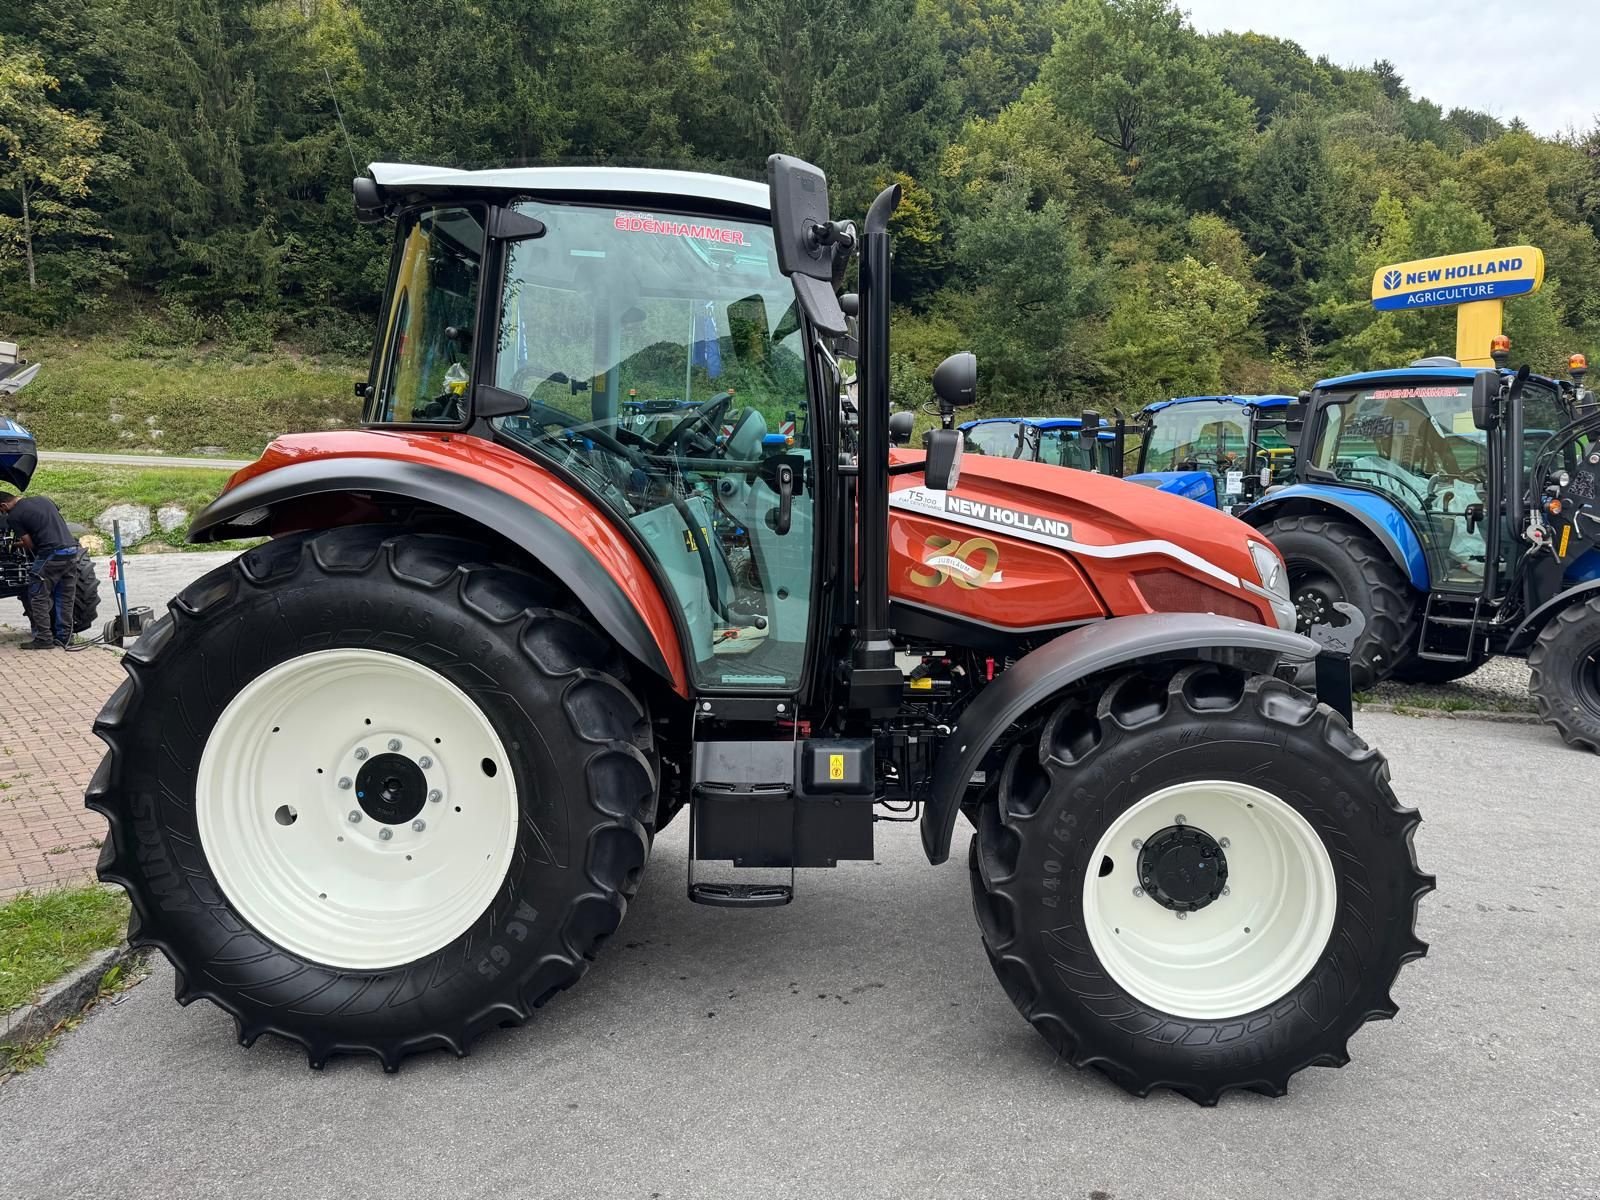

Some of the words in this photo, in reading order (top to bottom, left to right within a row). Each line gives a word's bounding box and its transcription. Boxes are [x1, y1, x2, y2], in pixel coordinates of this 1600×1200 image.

[614, 217, 744, 246] EIDENHAMMER
[1406, 269, 1442, 285] NEW
[1445, 258, 1523, 279] HOLLAND
[1407, 284, 1495, 304] AGRICULTURE
[948, 496, 986, 518] NEW
[989, 507, 1069, 537] HOLLAND
[909, 535, 999, 590] 30
